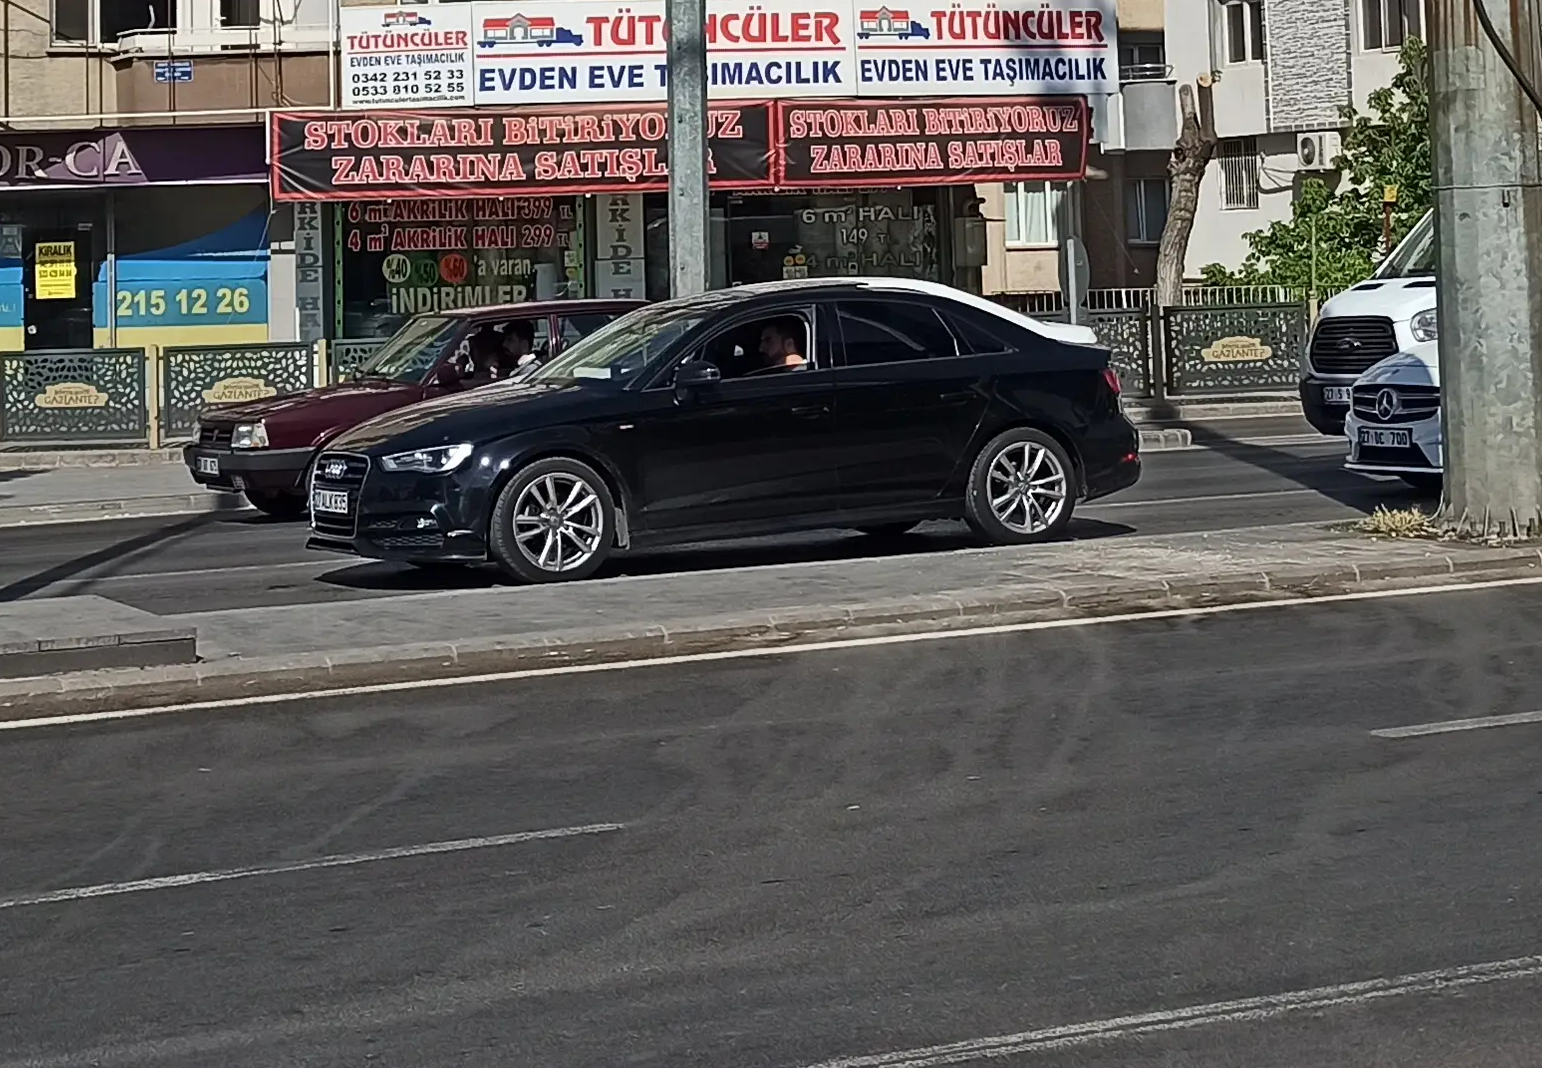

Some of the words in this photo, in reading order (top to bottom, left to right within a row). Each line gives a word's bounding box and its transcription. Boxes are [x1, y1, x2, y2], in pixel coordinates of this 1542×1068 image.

[585, 6, 841, 47] TÜTCÜLER
[930, 3, 1105, 43] TÜTÜNCÜLER
[347, 29, 468, 50] TÜTÜNCÜLER
[350, 56, 381, 67] EVDEN
[384, 55, 402, 66] EVE
[405, 52, 465, 67] TAŞIMACILIK
[860, 59, 928, 82] EVDEN
[935, 58, 973, 81] EVE
[979, 57, 1107, 87] TAŞIMACILIK
[352, 73, 388, 83] 0342
[393, 72, 418, 82] 231
[424, 70, 441, 81] 52
[447, 69, 464, 80] 33
[352, 86, 388, 96] 0533
[393, 84, 419, 95] 810
[424, 83, 442, 93] 52
[447, 82, 465, 92] 55
[479, 67, 577, 92] EVDEN
[588, 65, 644, 89] EVE
[654, 61, 842, 87] TIMACILIK
[304, 117, 494, 150] STOKLARI
[790, 108, 919, 139] STOKLARI
[332, 153, 526, 185] ZARARINA
[535, 148, 716, 183] SATIŞLR
[811, 142, 943, 173] ZARARINA
[947, 139, 1062, 172] SATIŞLAR
[348, 202, 360, 223] 6
[473, 198, 515, 221] HALI
[521, 197, 553, 219] 399
[802, 209, 815, 223] 6
[859, 206, 920, 221] HALI
[348, 231, 360, 252] 4
[473, 226, 515, 249] HALI
[522, 226, 554, 248] 299
[841, 229, 868, 244] 149
[862, 251, 921, 267] HALI
[117, 289, 166, 316] 215
[175, 288, 208, 315] 12
[216, 287, 250, 313] 26
